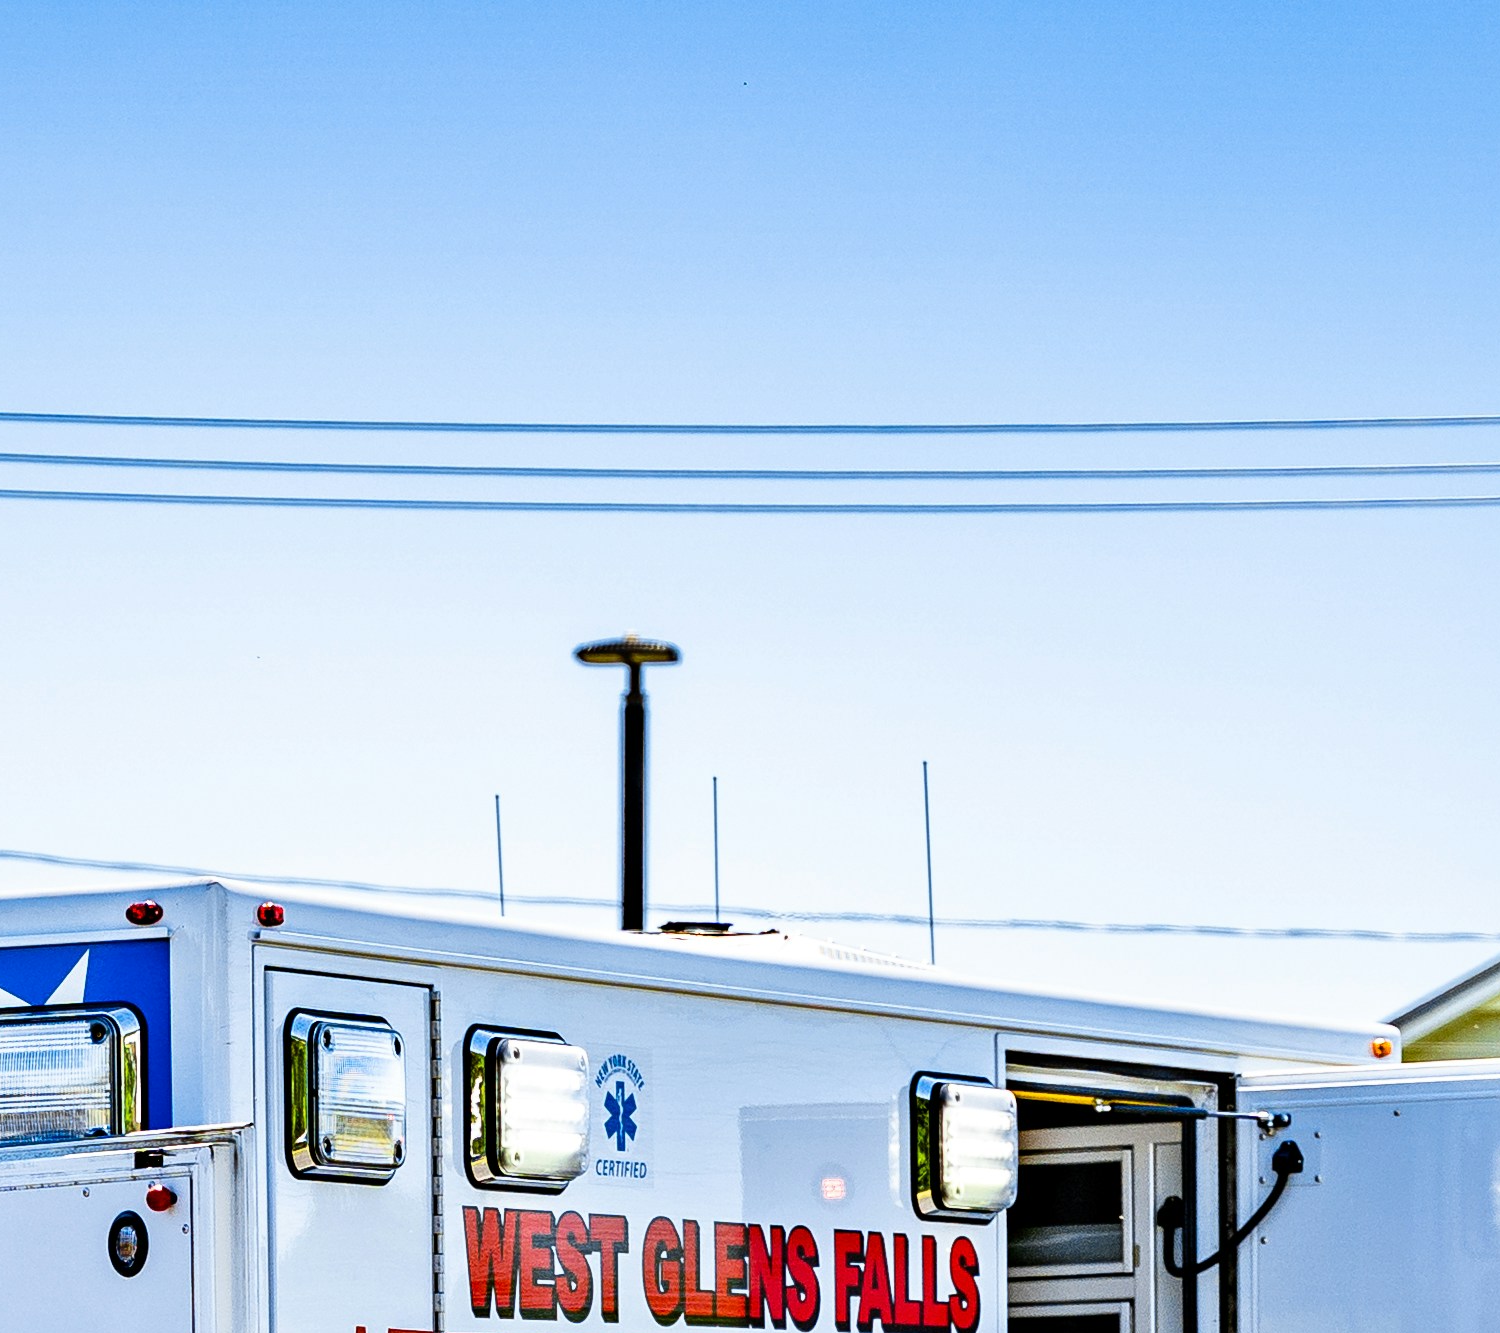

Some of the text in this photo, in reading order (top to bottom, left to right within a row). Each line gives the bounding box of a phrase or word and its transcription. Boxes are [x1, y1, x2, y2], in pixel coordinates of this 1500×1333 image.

[595, 1061, 609, 1088] NEW
[608, 1054, 627, 1069] YORK
[627, 1060, 645, 1091] STATE
[595, 1159, 647, 1178] CERTIFIED
[462, 1206, 629, 1324] WEST
[641, 1216, 820, 1333] GLENS
